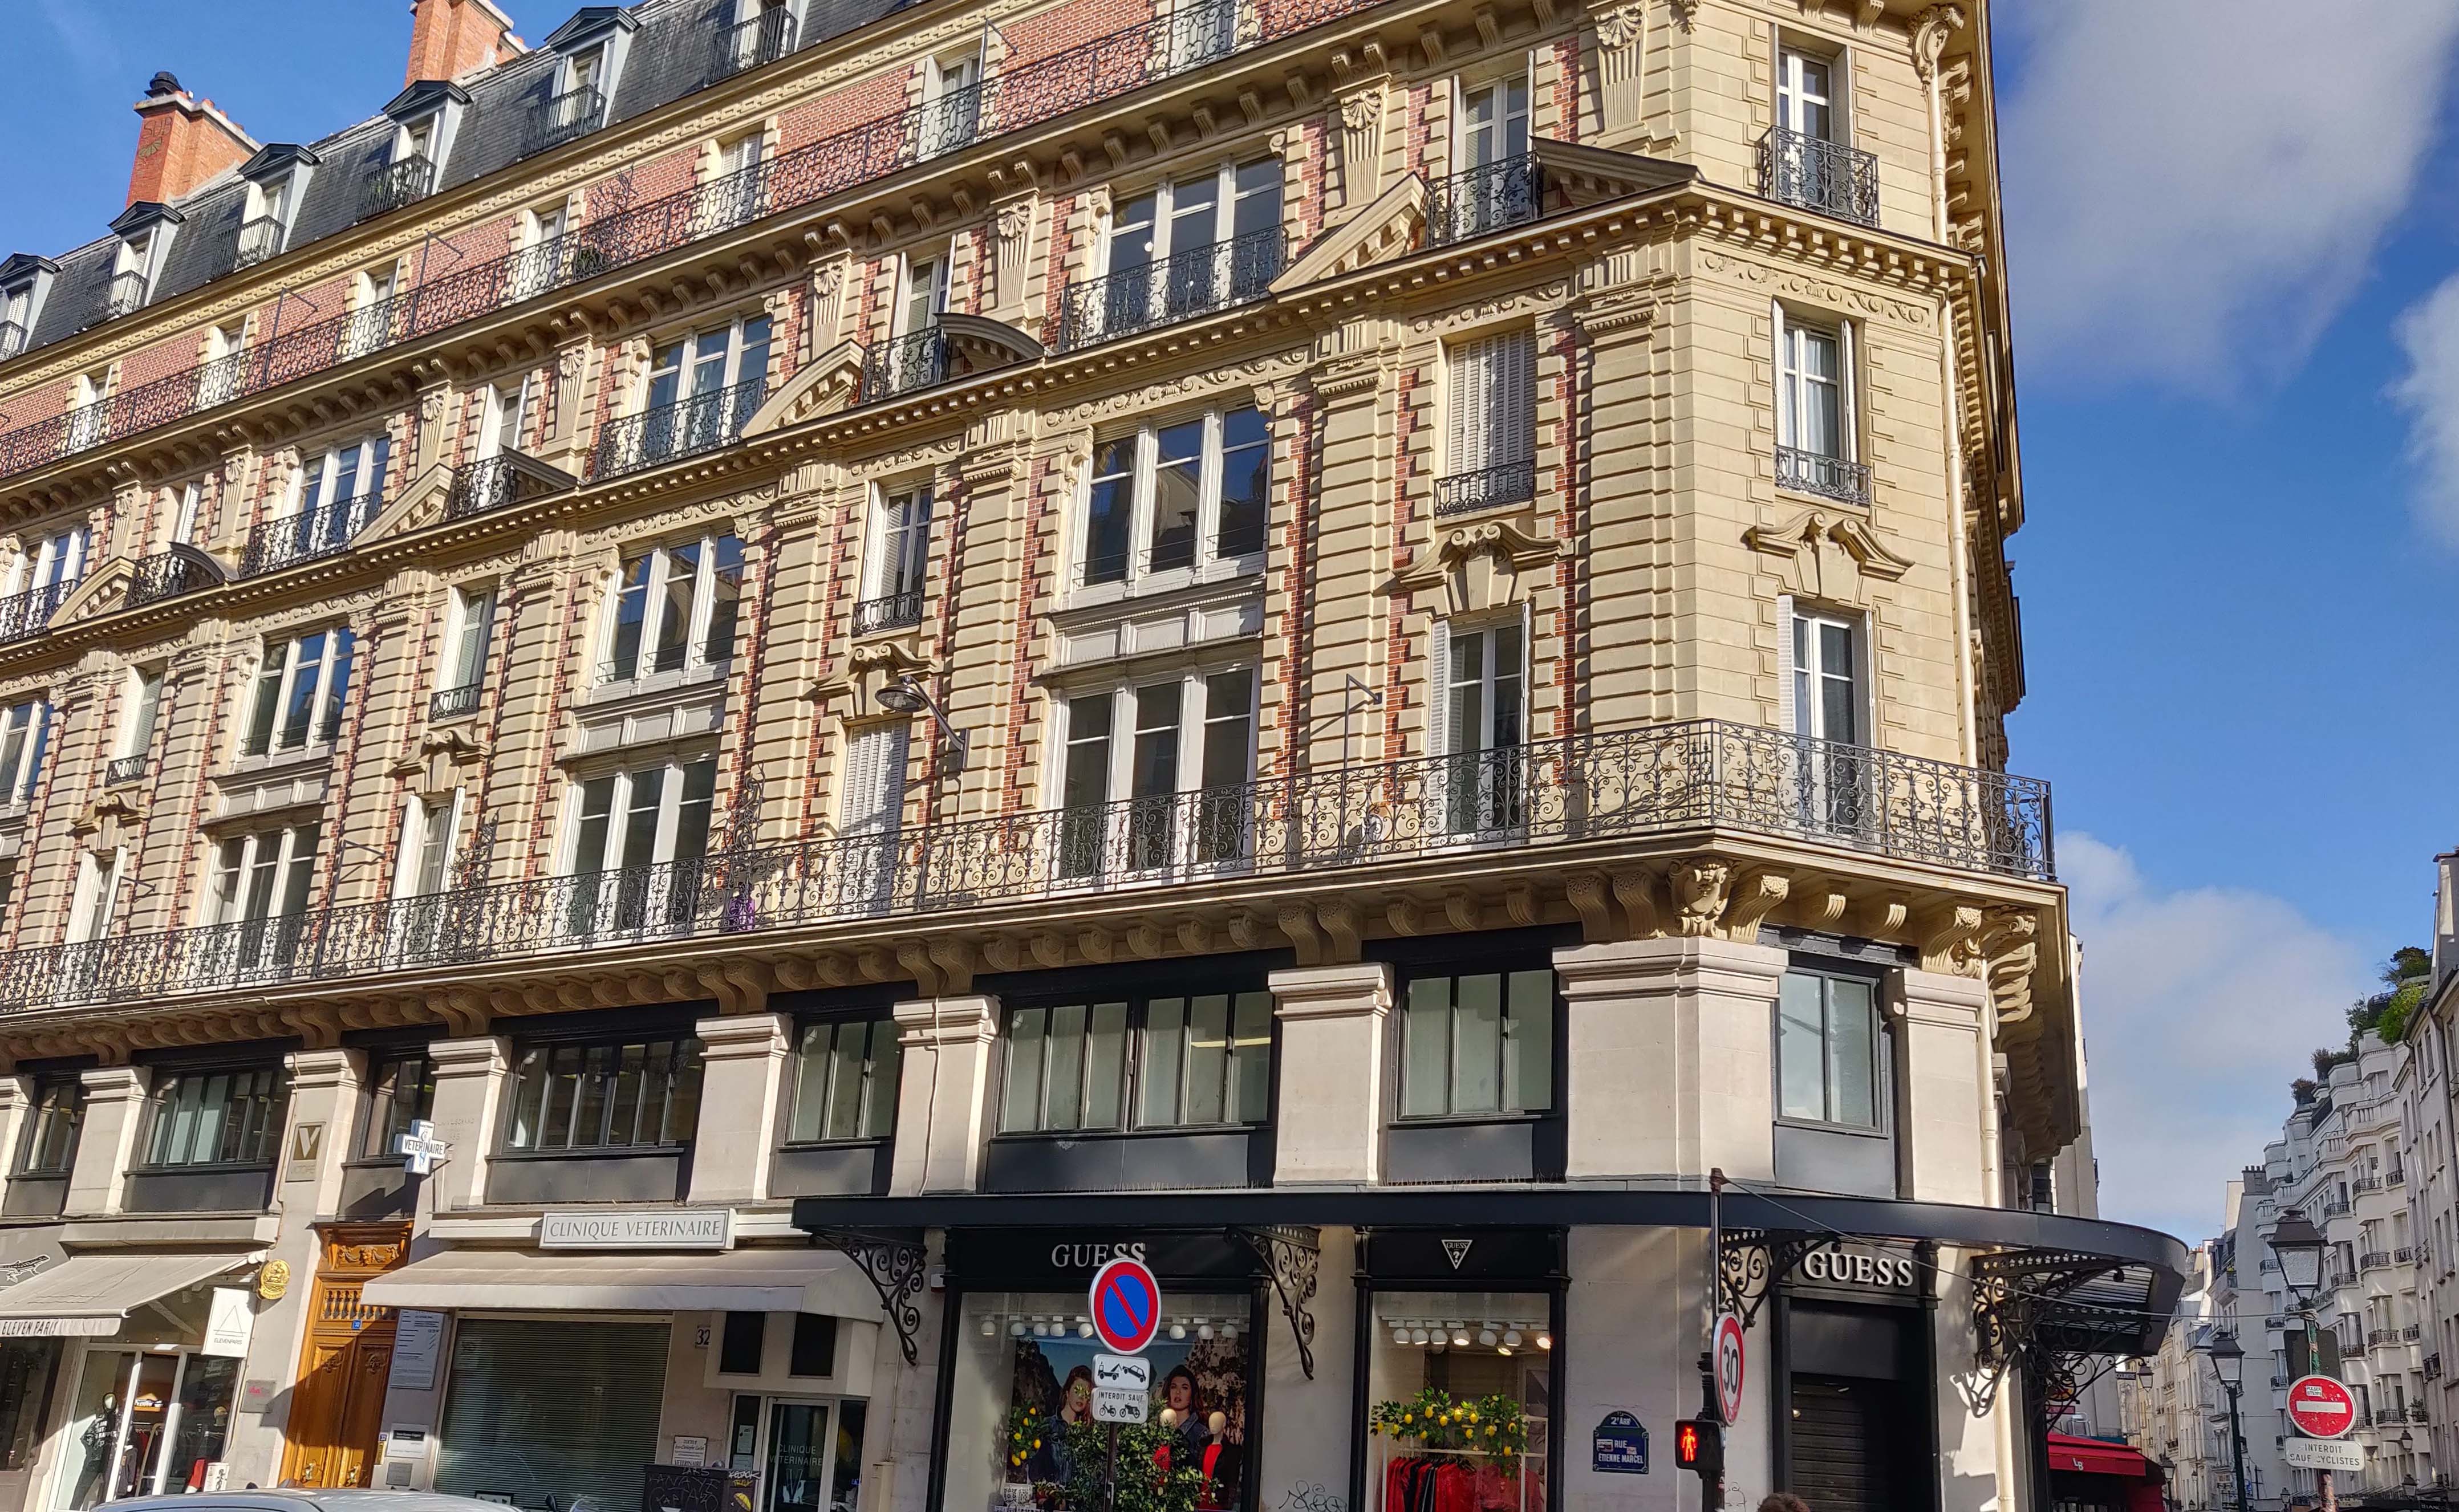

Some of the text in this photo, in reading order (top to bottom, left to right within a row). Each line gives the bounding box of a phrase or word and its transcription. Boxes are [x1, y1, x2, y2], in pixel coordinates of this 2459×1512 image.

[404, 1138, 444, 1155] VETERINAIRE
[550, 1220, 721, 1240] CLINIQUE VETERINAIRE
[1052, 1242, 1146, 1267] GUESS
[1804, 1251, 1913, 1287] GUESS
[2, 1320, 58, 1335] ELEVEN PARIS
[695, 1329, 711, 1345] 32
[1723, 1344, 1739, 1395] 30
[1098, 1391, 1125, 1400] INTERDIT
[1614, 1440, 1628, 1448] RUE
[2304, 1443, 2343, 1454] INTERDIT
[1621, 1454, 1644, 1464] MARCEL
[2290, 1453, 2310, 1462] SAUF
